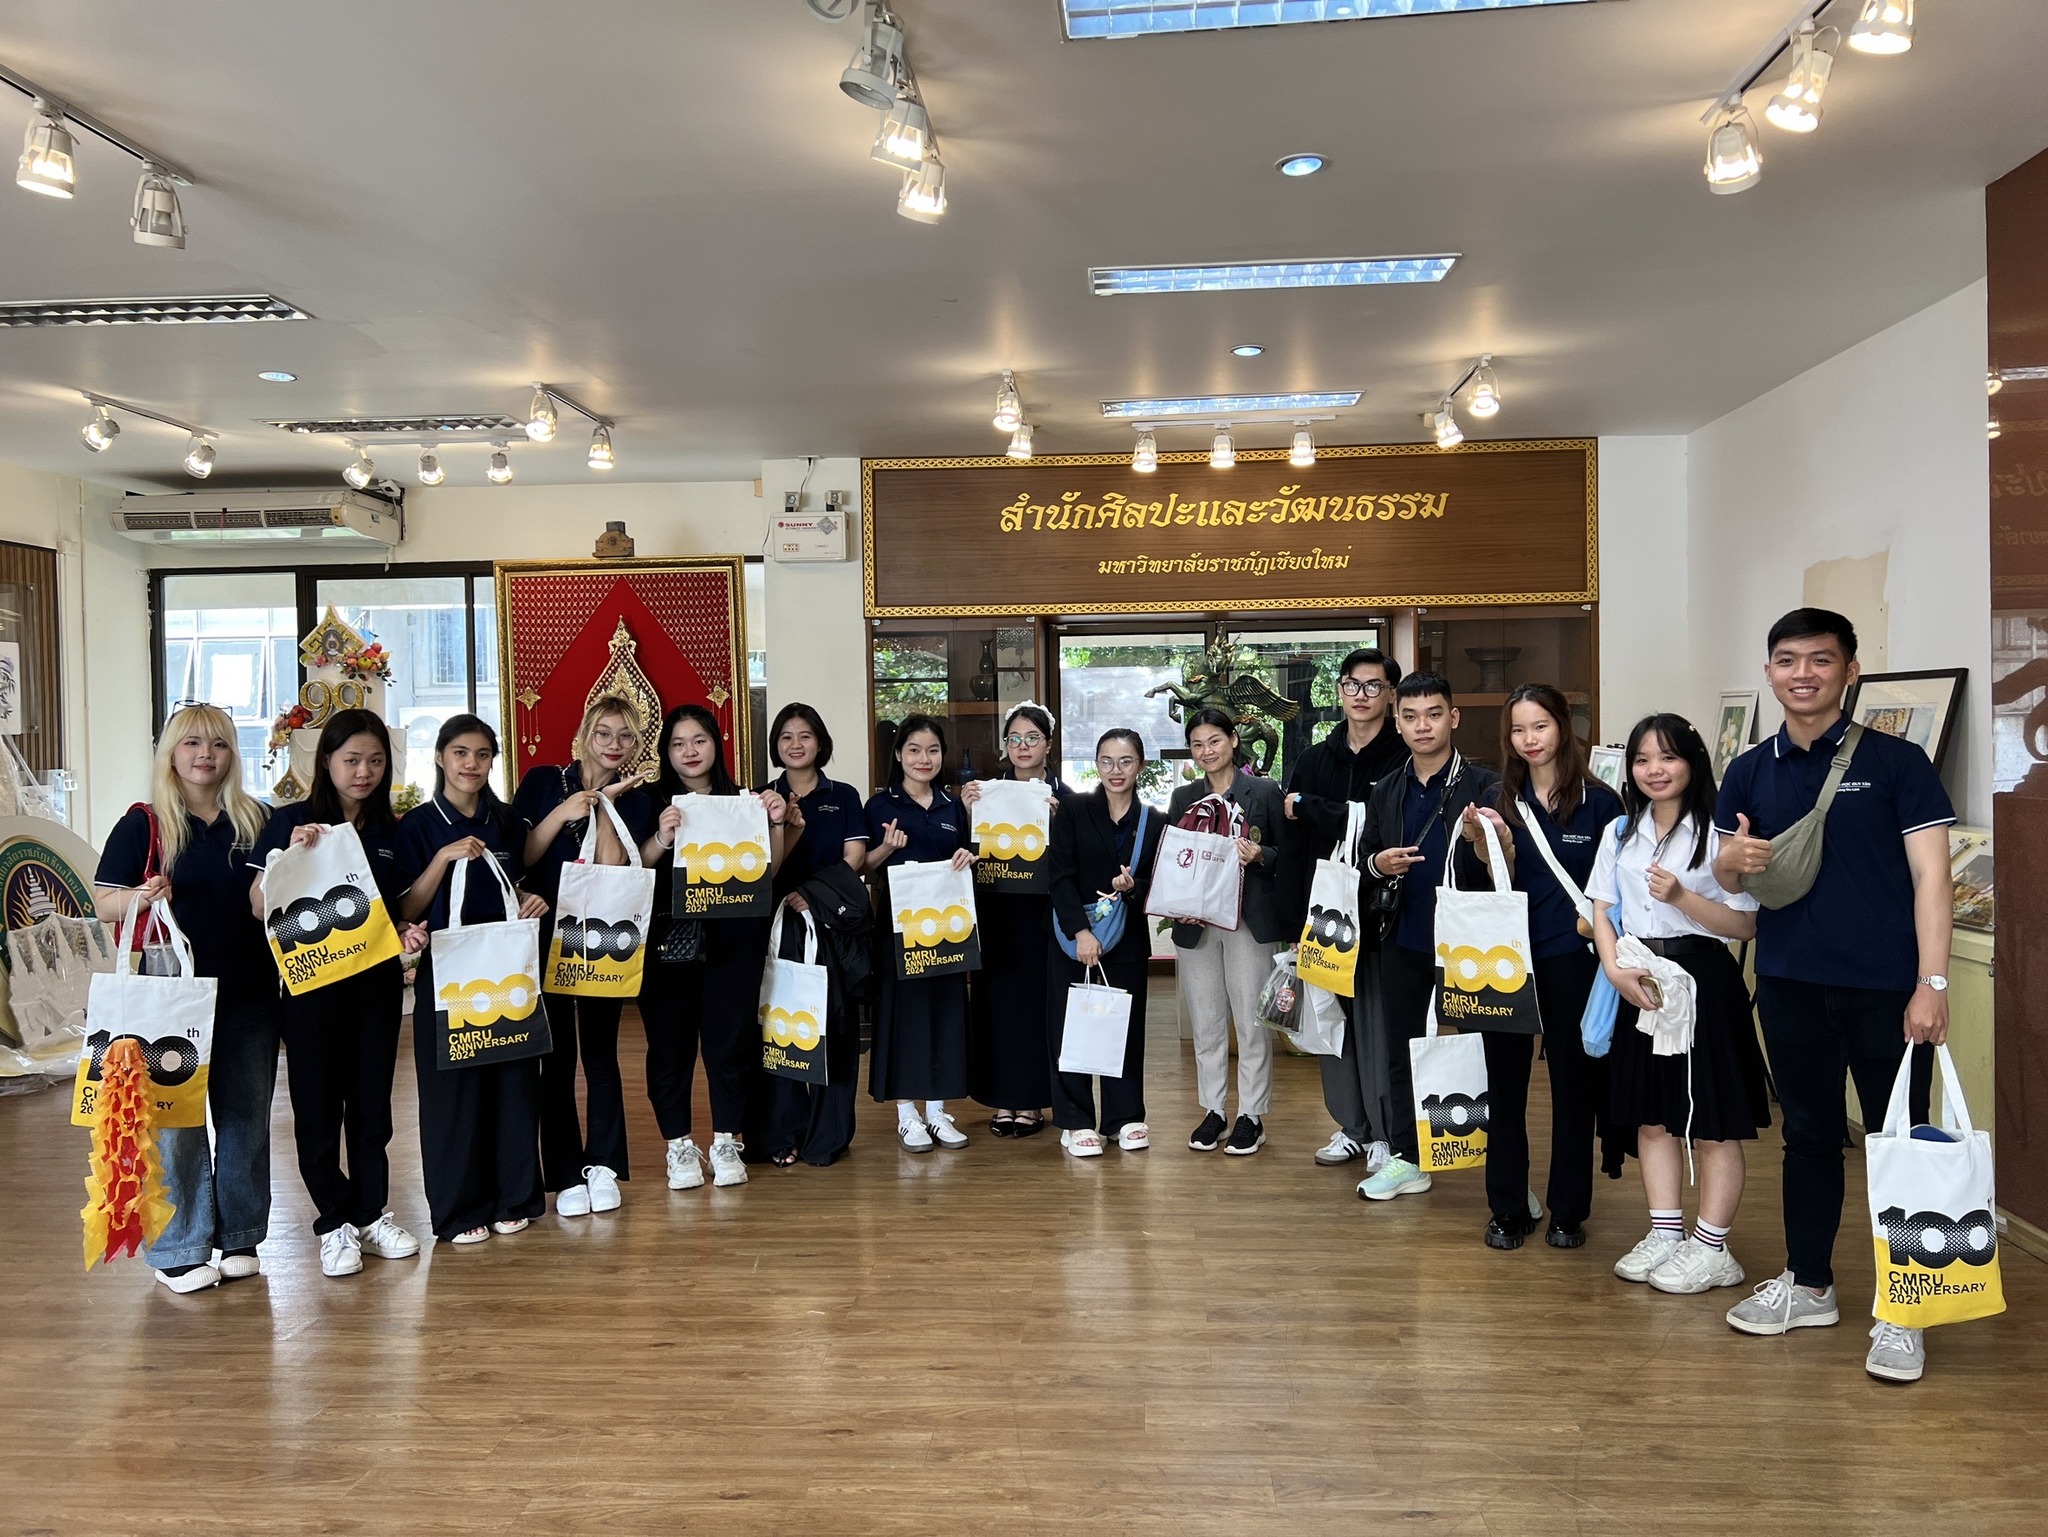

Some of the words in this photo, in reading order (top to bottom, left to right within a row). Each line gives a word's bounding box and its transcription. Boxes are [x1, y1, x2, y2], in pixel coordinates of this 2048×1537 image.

[1000, 484, 1450, 532] สำนักศิลปะและวัฒนธรรม
[1098, 545, 1353, 577] มหาวิทยาลัยราชภัฏเชียงใหม่
[975, 822, 1047, 862] 100
[680, 841, 768, 884] 100
[977, 862, 1009, 873] CMRU
[977, 870, 1034, 880] ANNIVERSARY
[977, 876, 994, 884] 2024
[685, 887, 723, 898] CMRU
[685, 894, 754, 906] ANNIVERSARY
[685, 904, 707, 913] 2024
[267, 884, 371, 955] 100
[897, 904, 974, 949] 100
[558, 914, 641, 962] 100
[284, 945, 329, 970] CMRU
[288, 941, 368, 978] ANNIVERSARY
[904, 949, 937, 961] CMRU
[1302, 944, 1326, 960] CMRU
[905, 953, 965, 968] ANNIVERSARY
[1300, 953, 1340, 972] ANNIVERSARY
[1437, 942, 1528, 994] 100
[557, 962, 595, 975] CMRU
[906, 966, 925, 975] 2024
[289, 970, 316, 985] 2024
[554, 979, 576, 987] 2024
[555, 972, 624, 982] ANNIVERSARY
[439, 973, 539, 1029] 100
[1443, 991, 1479, 1006] CMRU
[1443, 1001, 1514, 1016] ANNIVERSARY
[1443, 1008, 1465, 1019] 2024
[448, 1029, 492, 1045] CMRU
[449, 1032, 529, 1053] ANNIVERSARY
[87, 1029, 199, 1087] 10
[450, 1049, 475, 1061] 2024
[763, 1046, 786, 1058] CMRU
[762, 1054, 810, 1070] ANNIVERSARY
[1431, 1140, 1469, 1152] CMRU
[1432, 1147, 1487, 1159] ANNIVERSA
[1432, 1158, 1454, 1166] 2024
[1878, 1205, 1997, 1269] 100
[1888, 1271, 1944, 1286] CMRU
[1889, 1282, 1987, 1296] ANNIVERSARY
[1890, 1293, 1921, 1305] 2024
